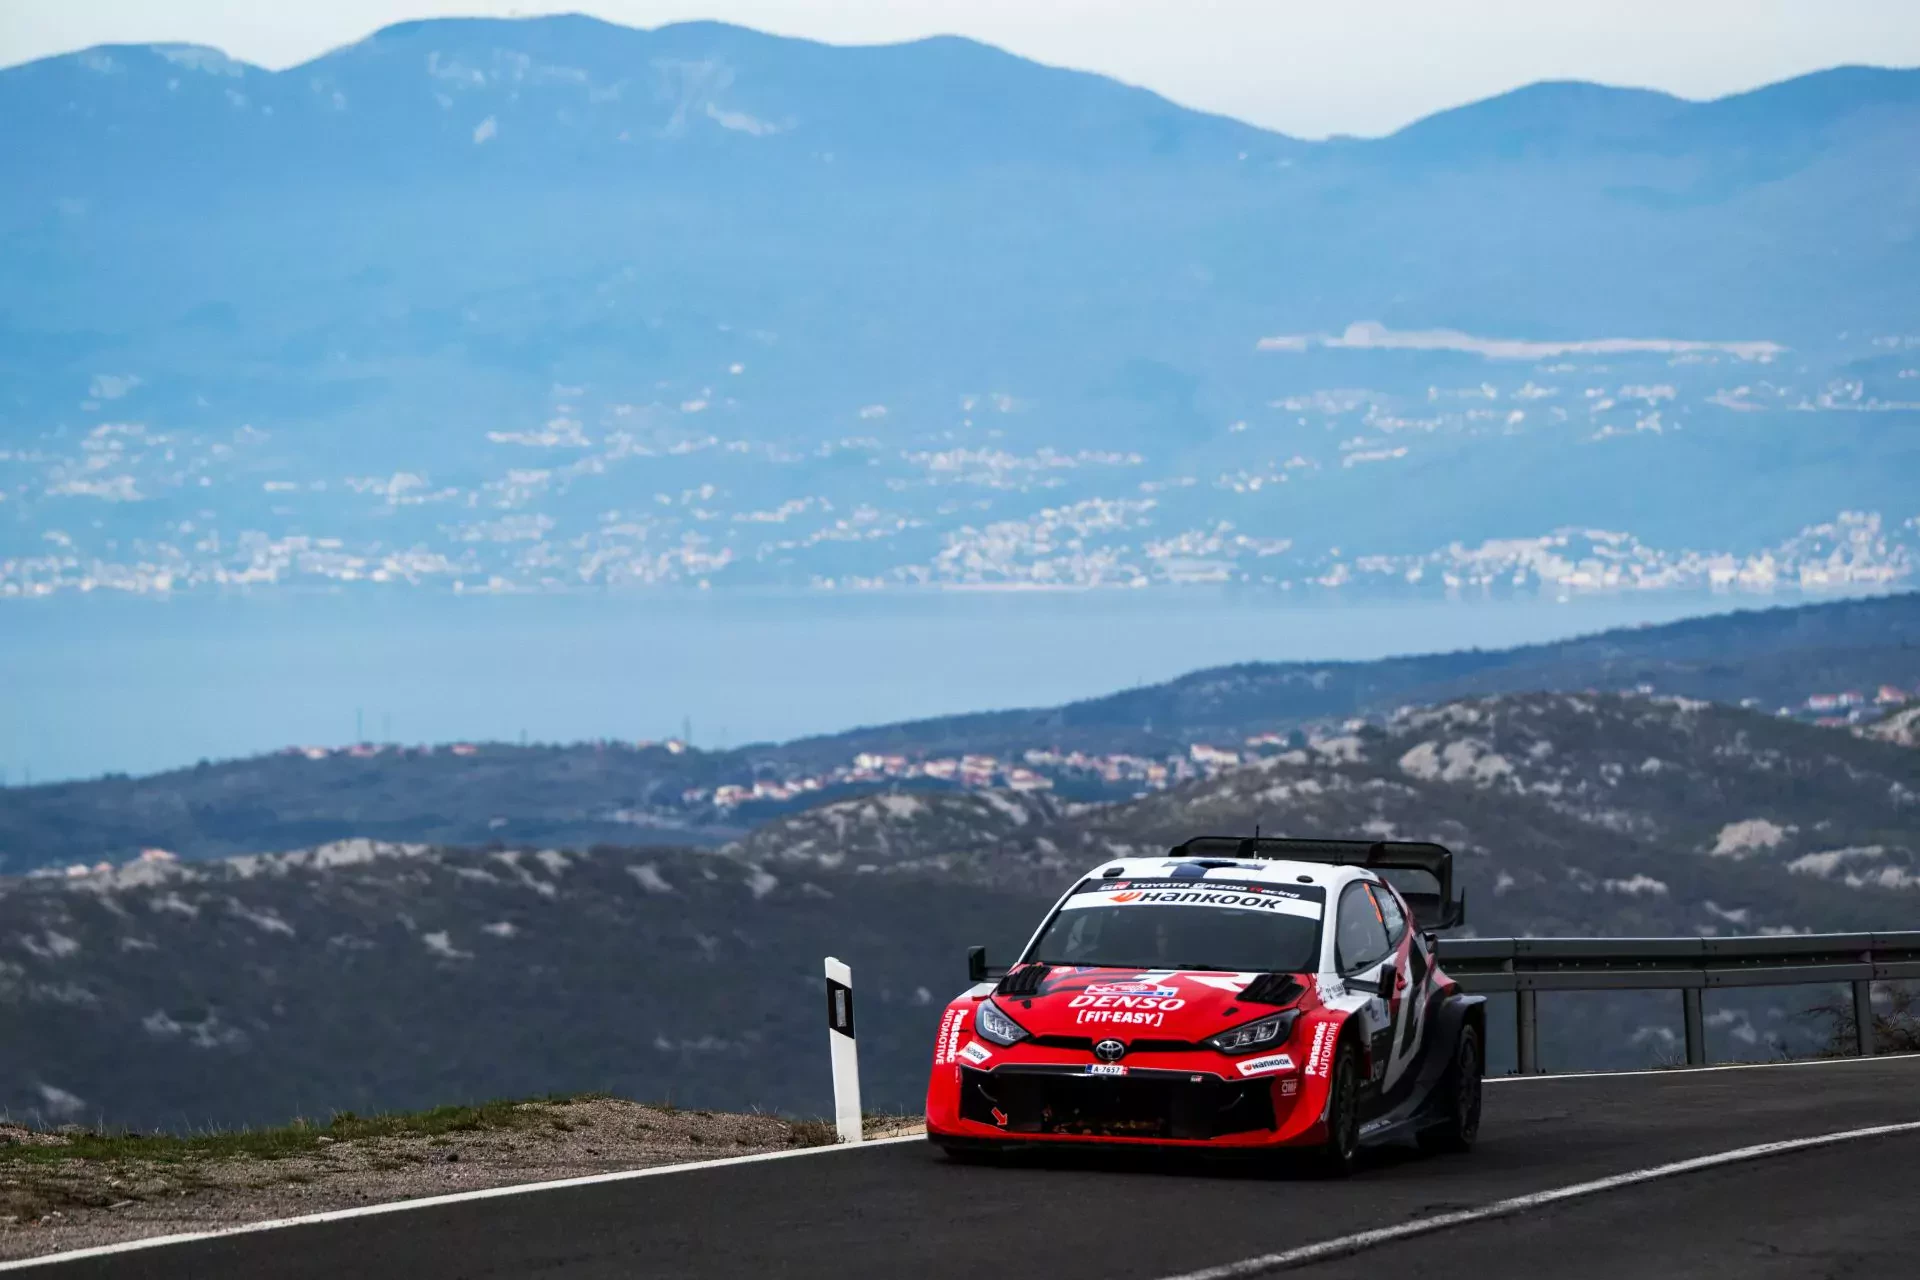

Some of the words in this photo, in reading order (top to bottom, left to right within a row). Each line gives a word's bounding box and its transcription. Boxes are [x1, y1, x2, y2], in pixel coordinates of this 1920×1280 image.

[1191, 882, 1248, 891] GAZOO
[1068, 995, 1186, 1011] DENSO
[935, 1009, 955, 1065] AUTOMOTIVE
[946, 1009, 969, 1063] Panasonic
[1305, 1021, 1328, 1076] Panasonic
[1318, 1022, 1339, 1078] AUTOMOTIVE
[1093, 1065, 1121, 1074] A-7657
